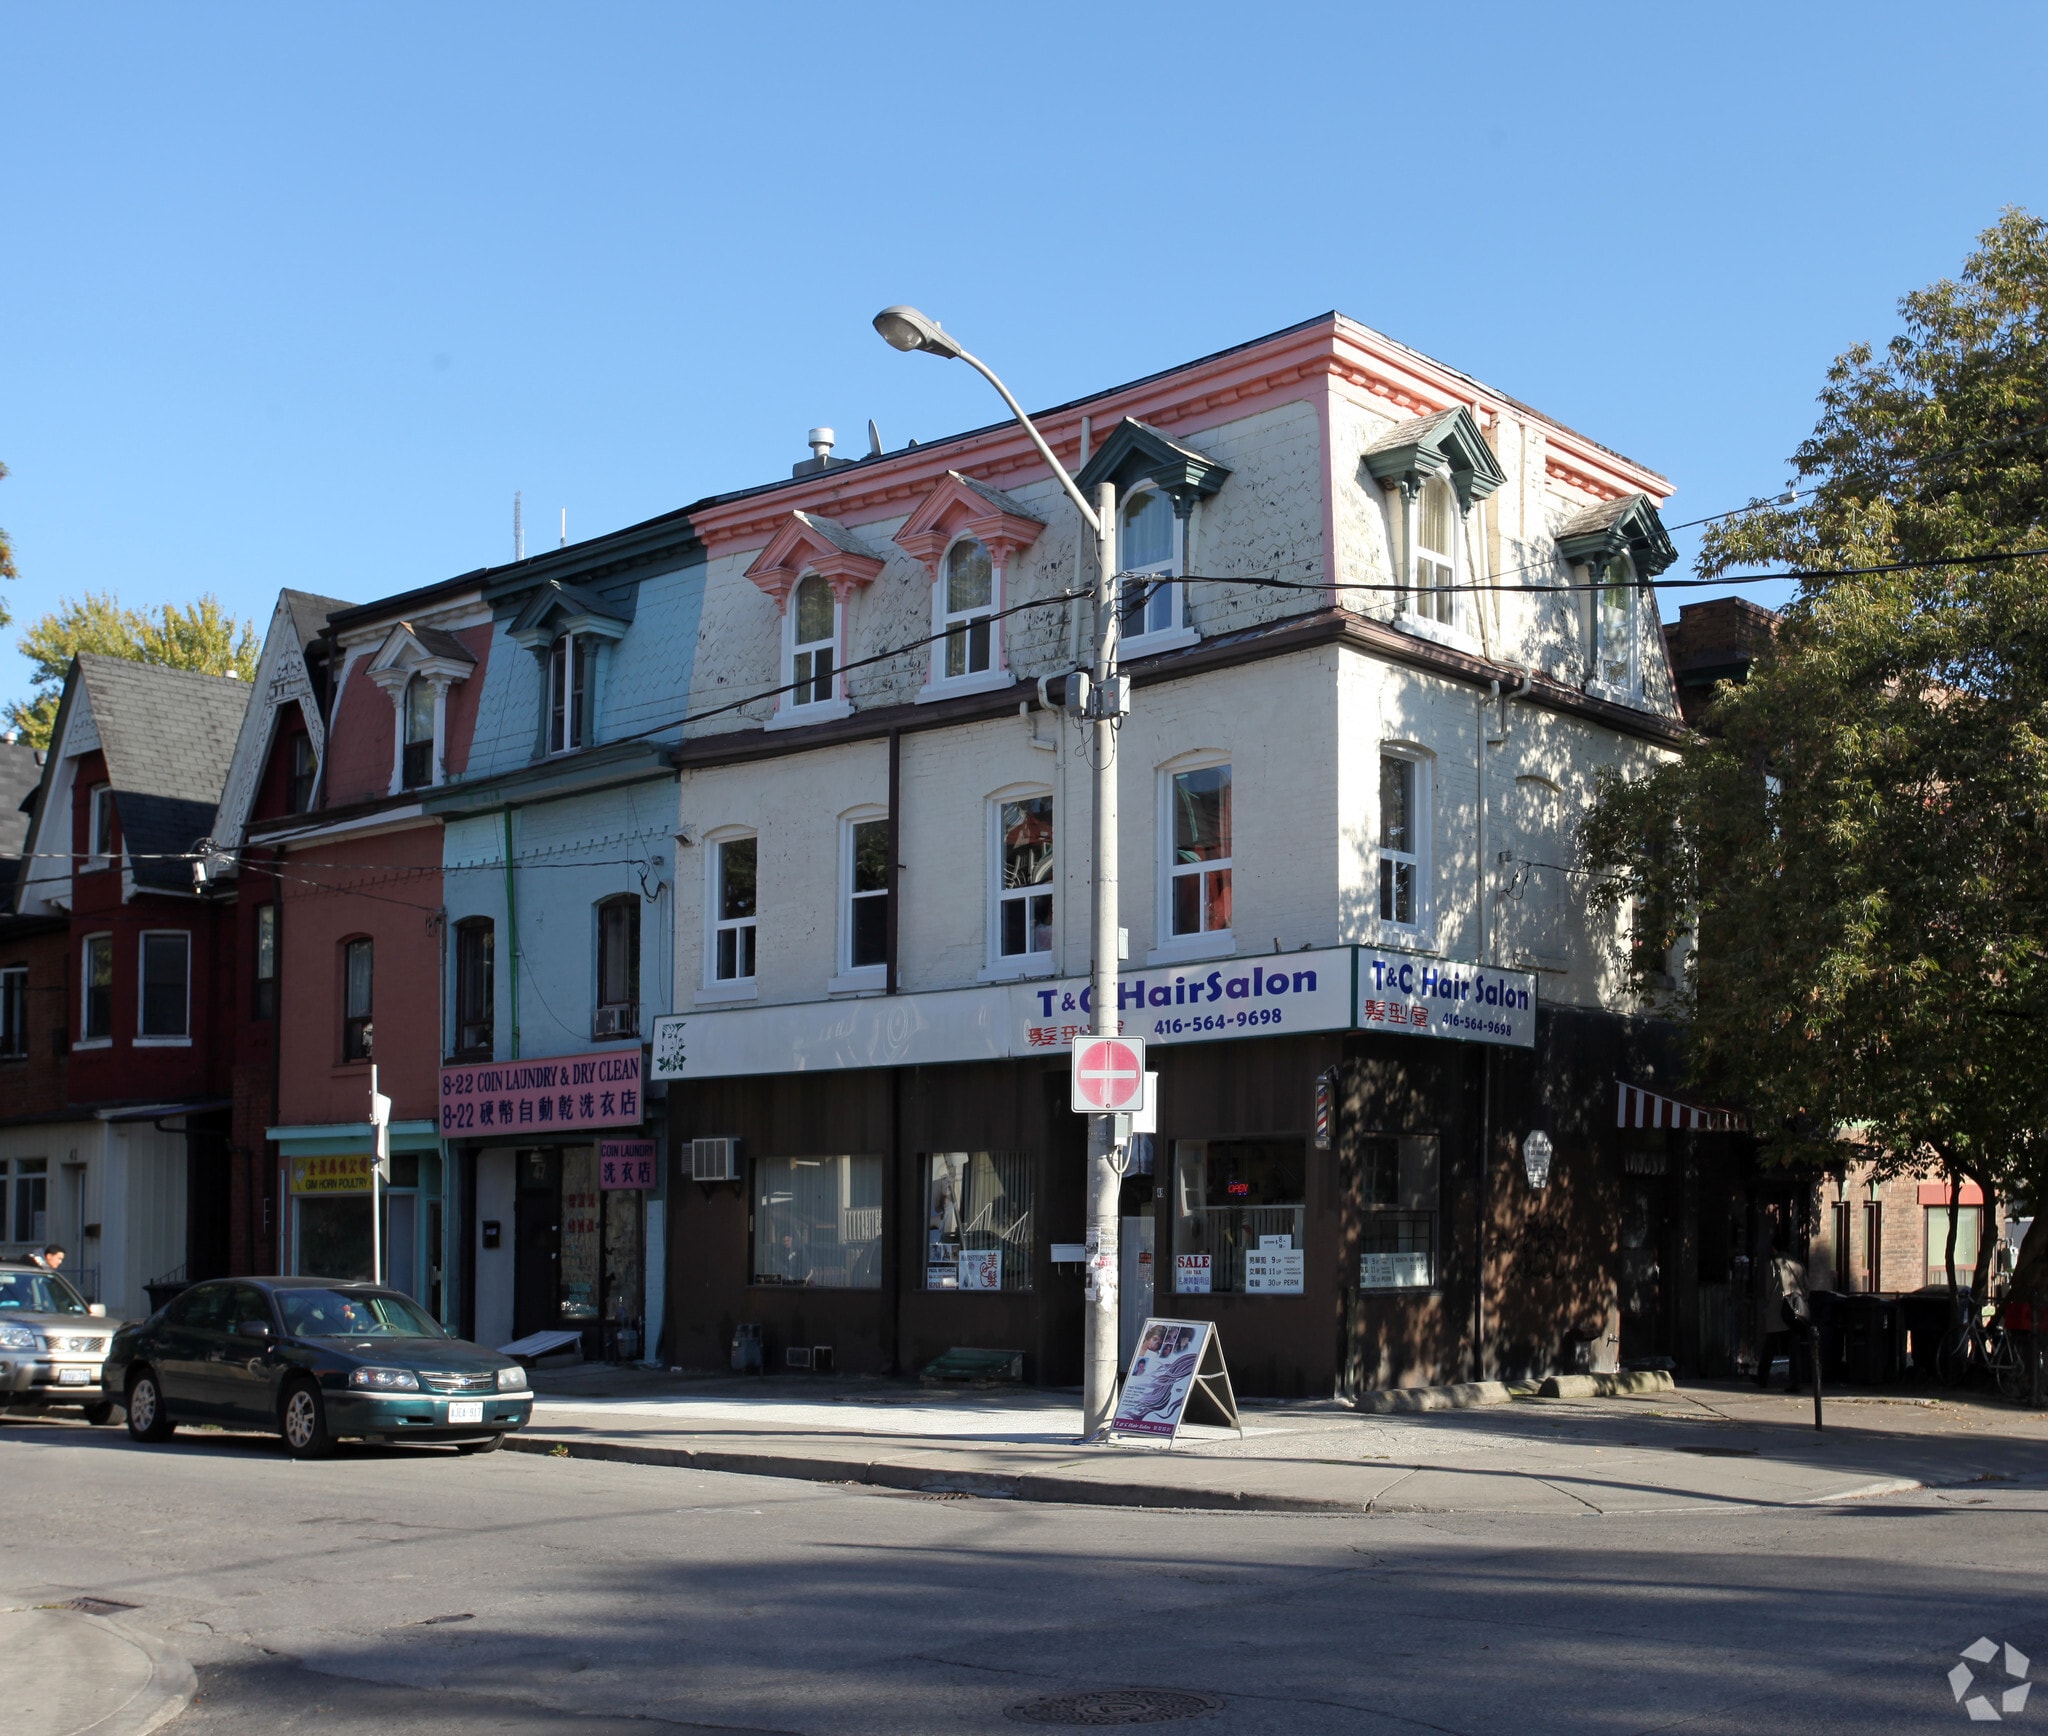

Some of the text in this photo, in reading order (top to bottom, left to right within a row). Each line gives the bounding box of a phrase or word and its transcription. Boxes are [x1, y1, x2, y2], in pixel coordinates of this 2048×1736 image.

[1372, 960, 1529, 1011] T&C Hair Salon
[1155, 1008, 1282, 1035] 416-564-9698
[1443, 1013, 1512, 1037] 416-564-9698
[442, 1057, 639, 1095] 8-22 COIN LAUNDRY & DRY CLEAN
[443, 1103, 474, 1129] 8-22
[601, 1144, 654, 1157] COIN LAUNDRY
[338, 1177, 367, 1189] POULTRY
[604, 1161, 651, 1183] 洗衣店
[1228, 1183, 1248, 1193] OPEN
[1178, 1256, 1210, 1268] SALE
